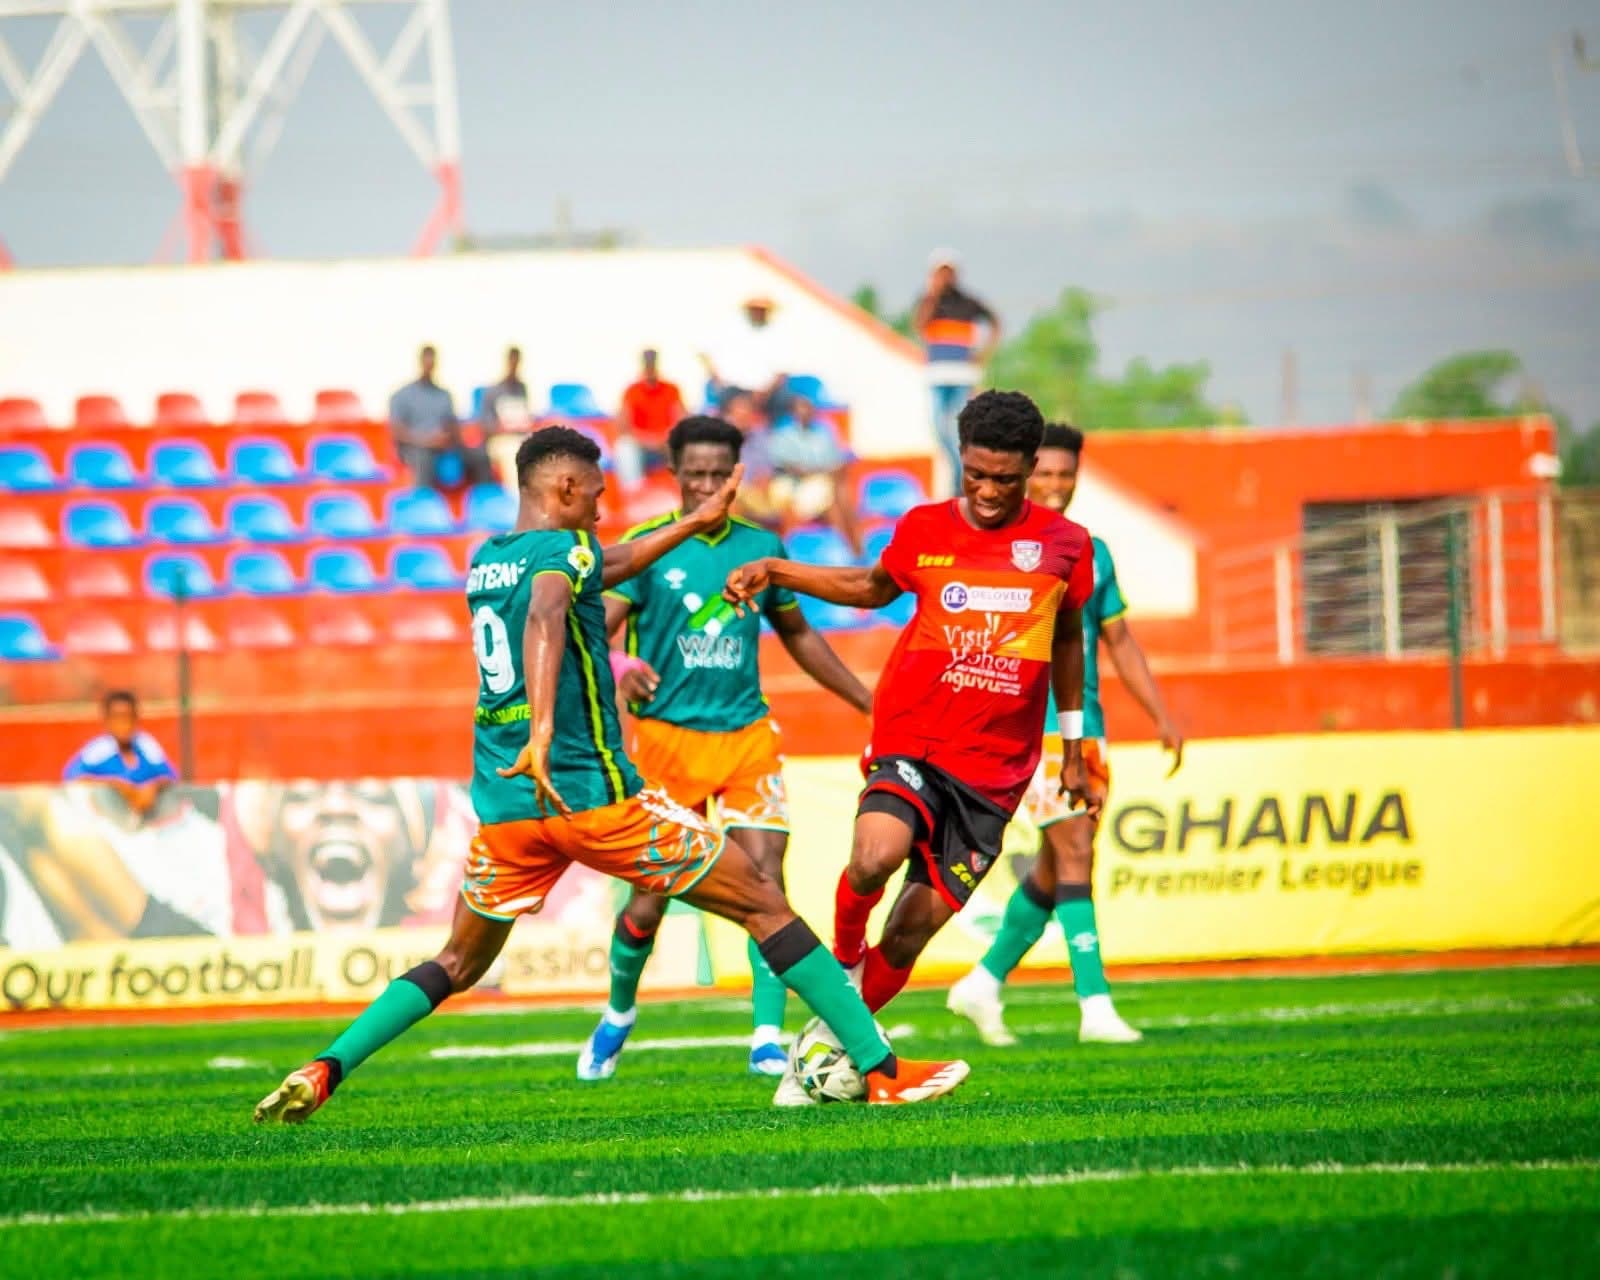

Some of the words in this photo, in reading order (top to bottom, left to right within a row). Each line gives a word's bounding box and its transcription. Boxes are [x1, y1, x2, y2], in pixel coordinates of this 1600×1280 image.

[677, 634, 742, 657] WIN
[943, 625, 993, 648] Visit
[684, 654, 742, 669] ENERGY
[940, 670, 1001, 693] nguvu
[1113, 793, 1411, 855] GHANA
[1111, 864, 1264, 894] Premier
[1281, 858, 1421, 893] League
[3, 961, 94, 1003] Our
[343, 947, 433, 987] Ou
